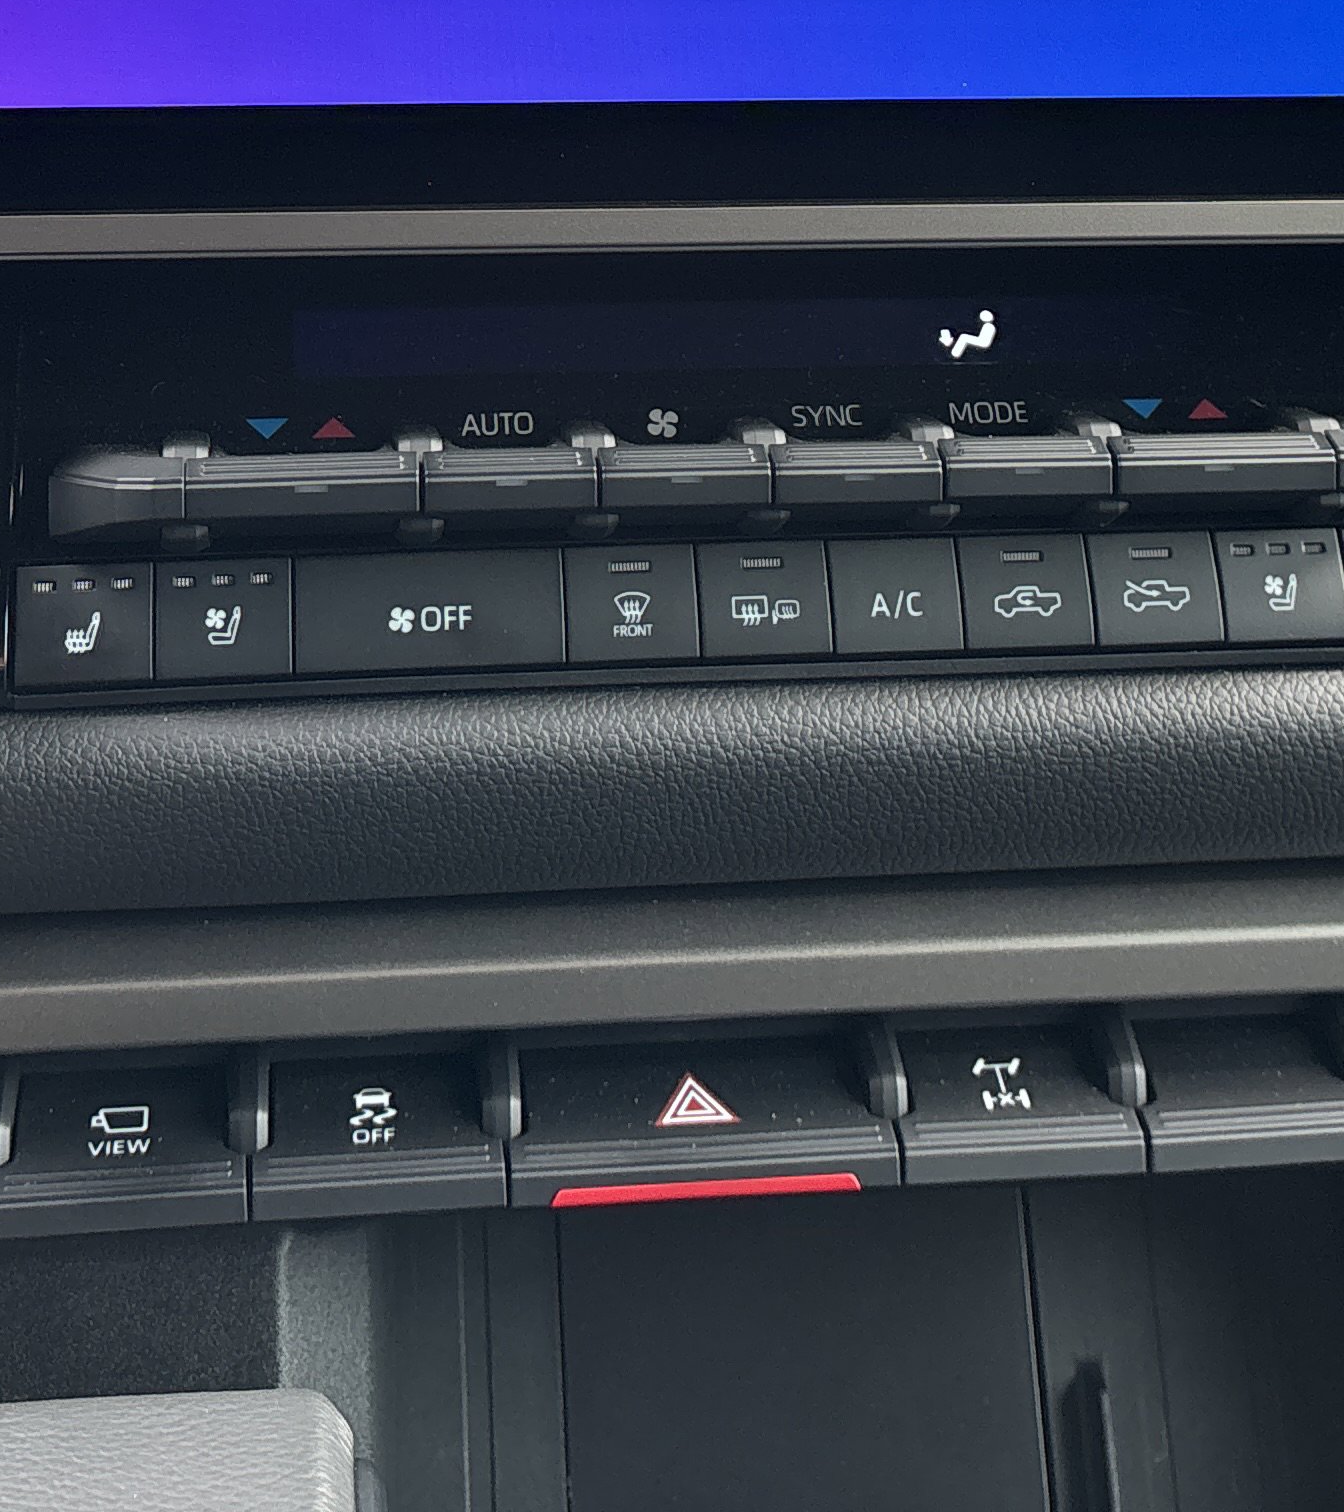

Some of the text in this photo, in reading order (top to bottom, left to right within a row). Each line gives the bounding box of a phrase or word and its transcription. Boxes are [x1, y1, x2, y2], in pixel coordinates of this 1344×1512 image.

[461, 411, 534, 437] AUTO
[791, 404, 863, 428] SYNC
[949, 400, 1029, 424] MODE
[870, 590, 924, 619] A/C
[420, 605, 473, 632] OFF
[612, 624, 653, 638] FRONT
[87, 1138, 151, 1156] VIEW
[349, 1127, 396, 1145] OFF
